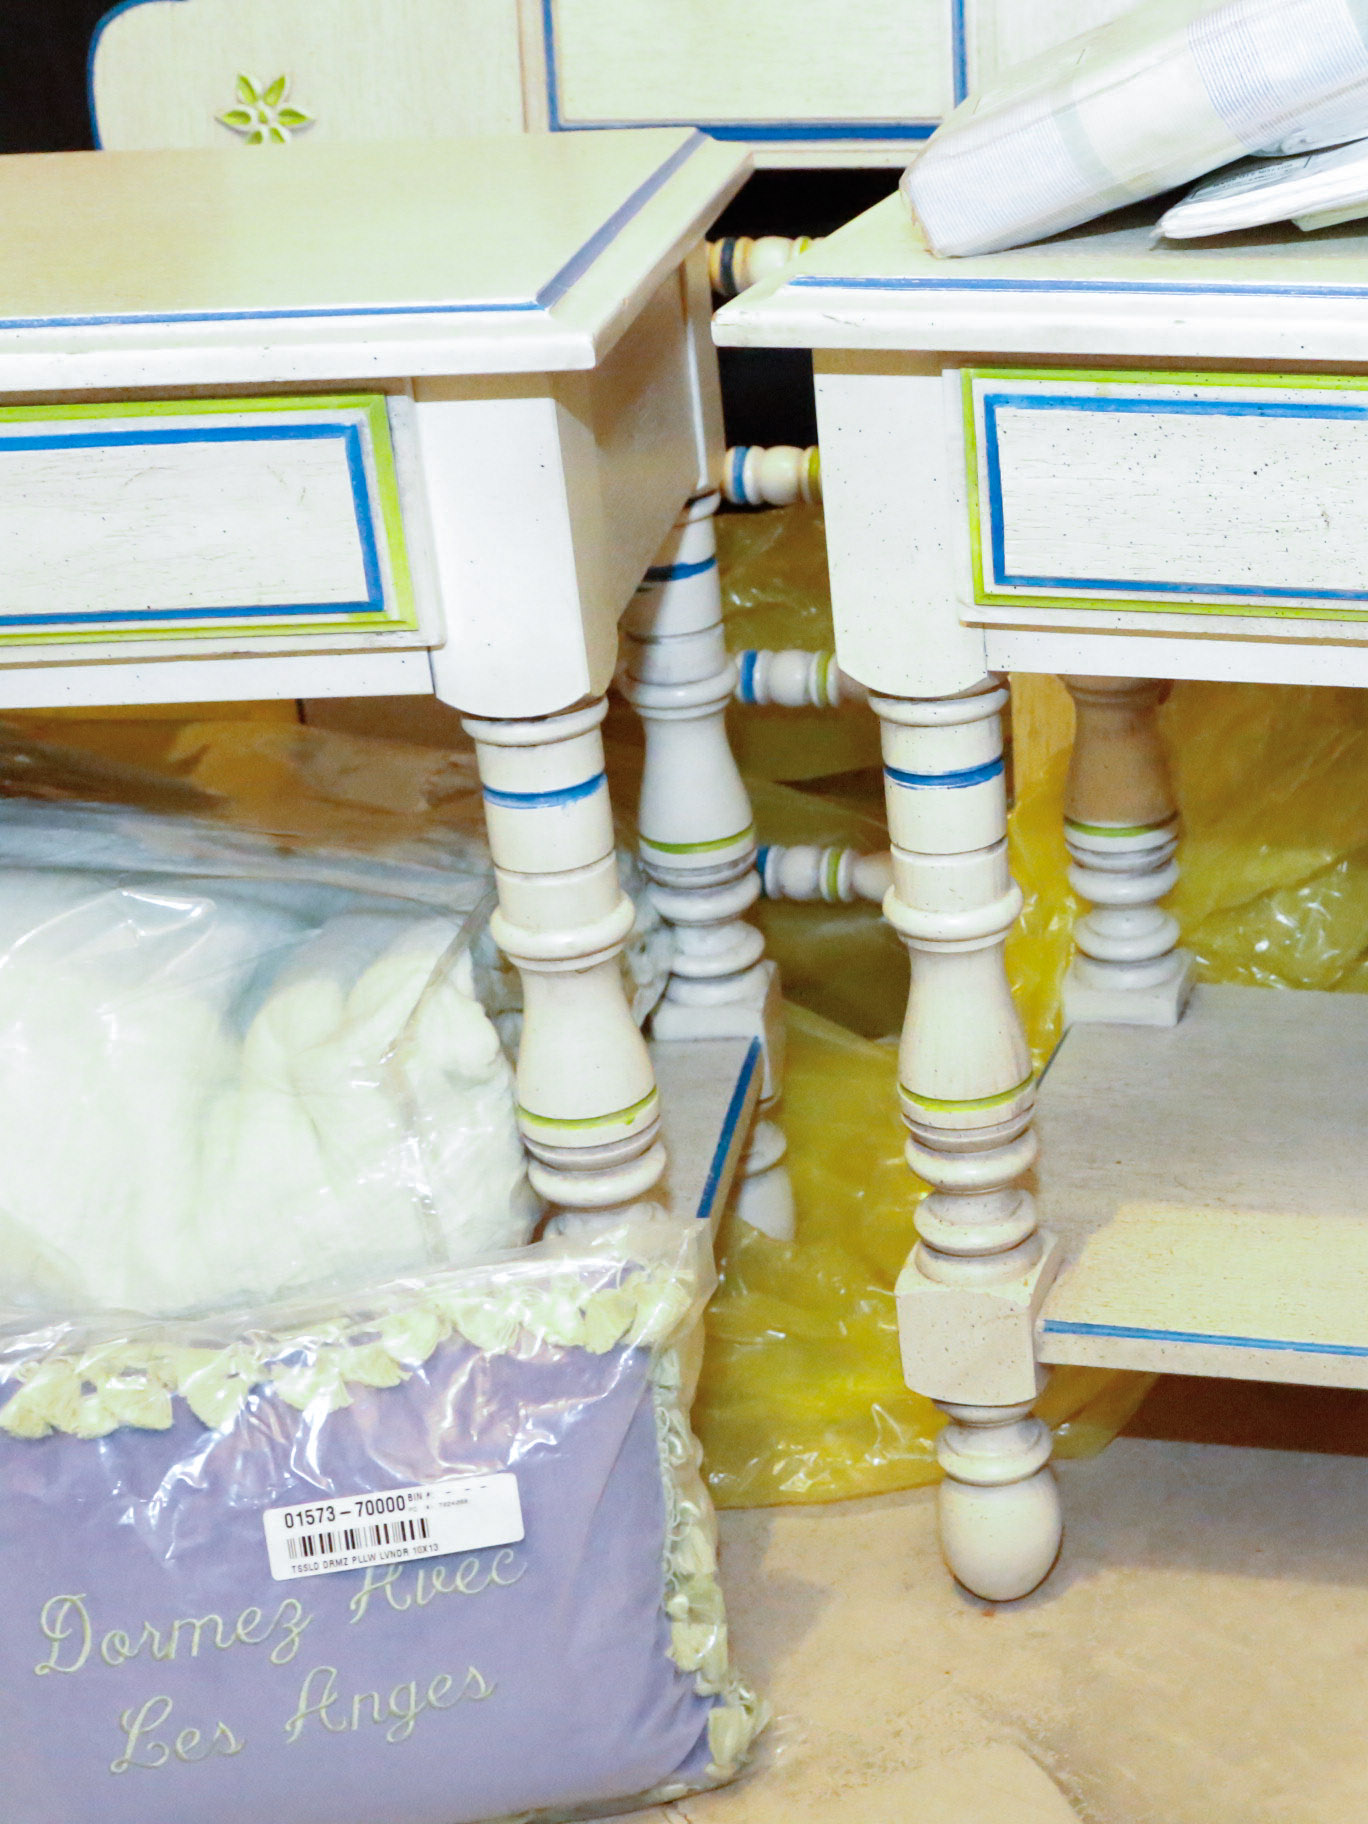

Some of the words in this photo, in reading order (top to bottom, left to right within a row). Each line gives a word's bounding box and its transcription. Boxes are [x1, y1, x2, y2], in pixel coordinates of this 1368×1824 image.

[292, 1561, 320, 1573] TSSLD
[323, 1558, 348, 1568] DRMZ
[352, 1554, 377, 1565] PLLW
[380, 1549, 409, 1560] LVNDR
[34, 1593, 313, 1675] Dormez
[110, 1695, 244, 1773] Les
[285, 1665, 498, 1743] Anges
